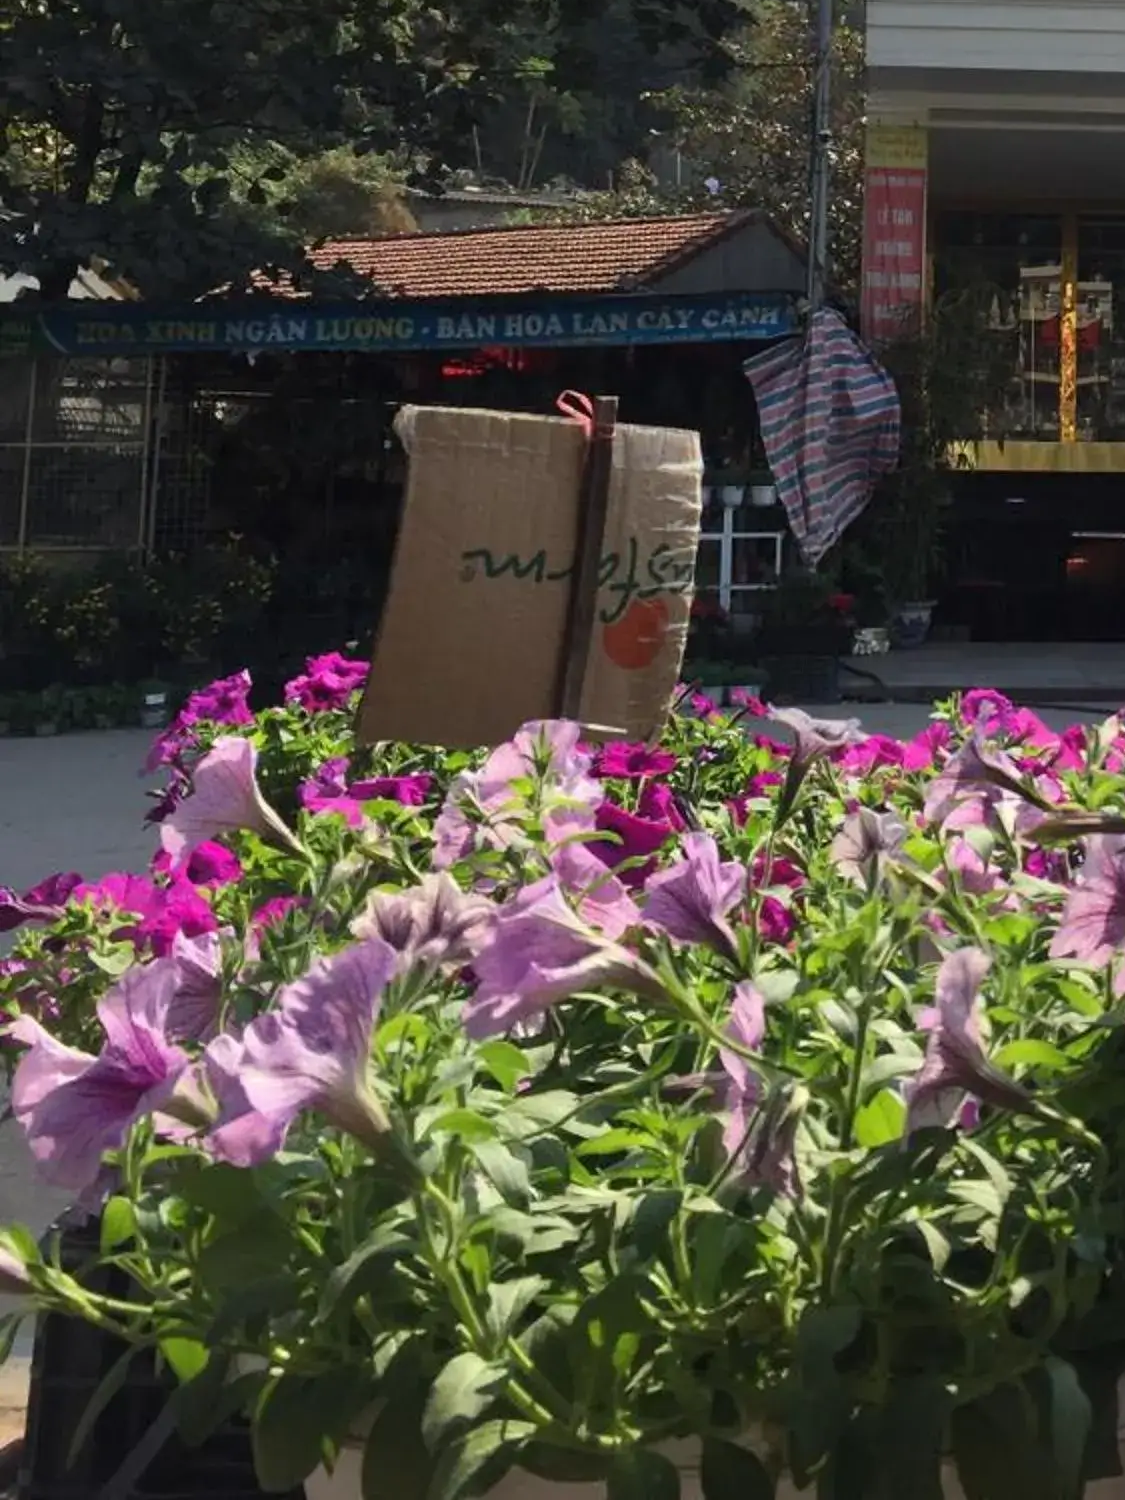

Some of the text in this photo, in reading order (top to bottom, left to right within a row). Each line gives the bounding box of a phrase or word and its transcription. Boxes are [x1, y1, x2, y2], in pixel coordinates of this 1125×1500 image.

[76, 321, 137, 344] HOA
[144, 320, 216, 343] XINH
[224, 313, 307, 343] NGÂN
[503, 313, 565, 337] HOA
[572, 310, 629, 334] LAN
